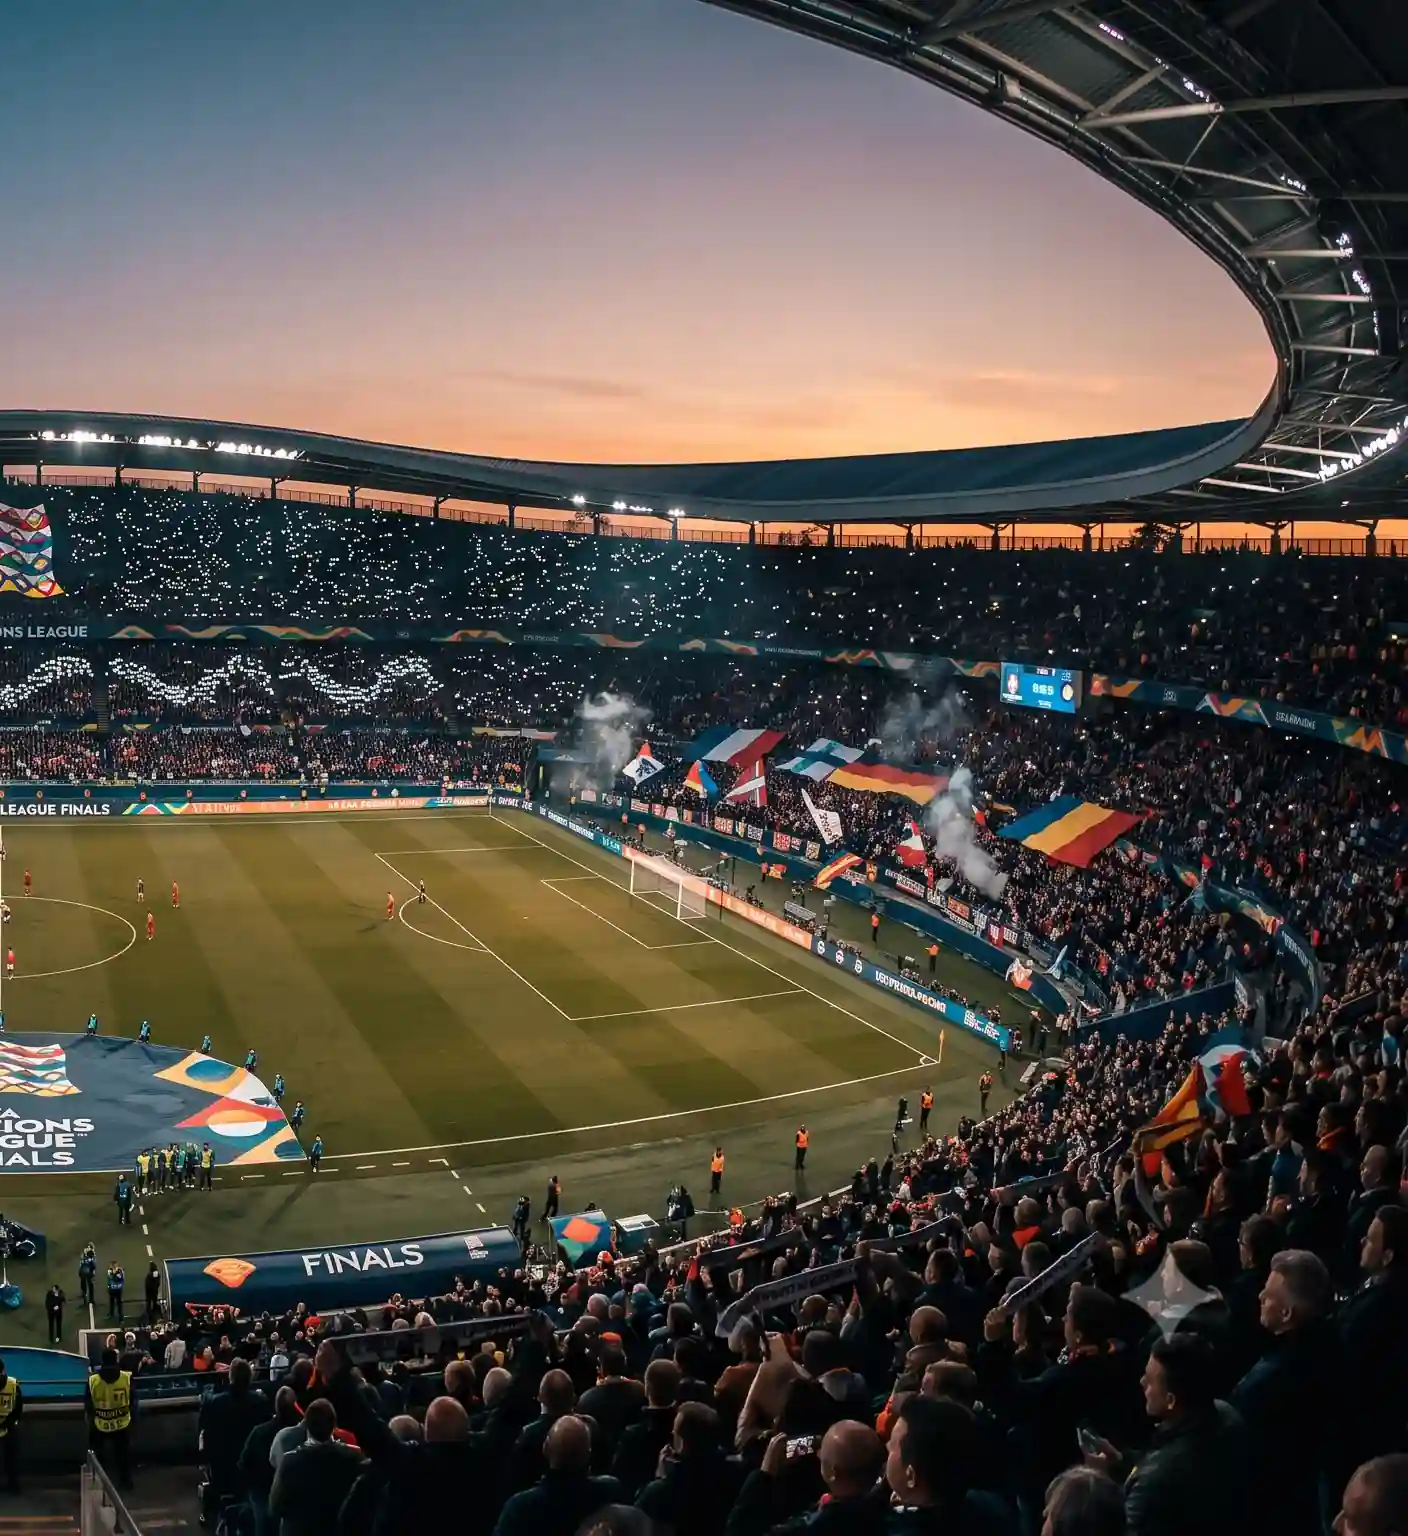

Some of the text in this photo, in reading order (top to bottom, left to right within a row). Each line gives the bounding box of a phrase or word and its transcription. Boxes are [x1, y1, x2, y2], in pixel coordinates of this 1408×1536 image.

[27, 625, 88, 638] LEAGUE
[0, 803, 57, 816] LEAGUE
[60, 803, 110, 816] FINALS
[301, 1244, 424, 1276] FINALS
